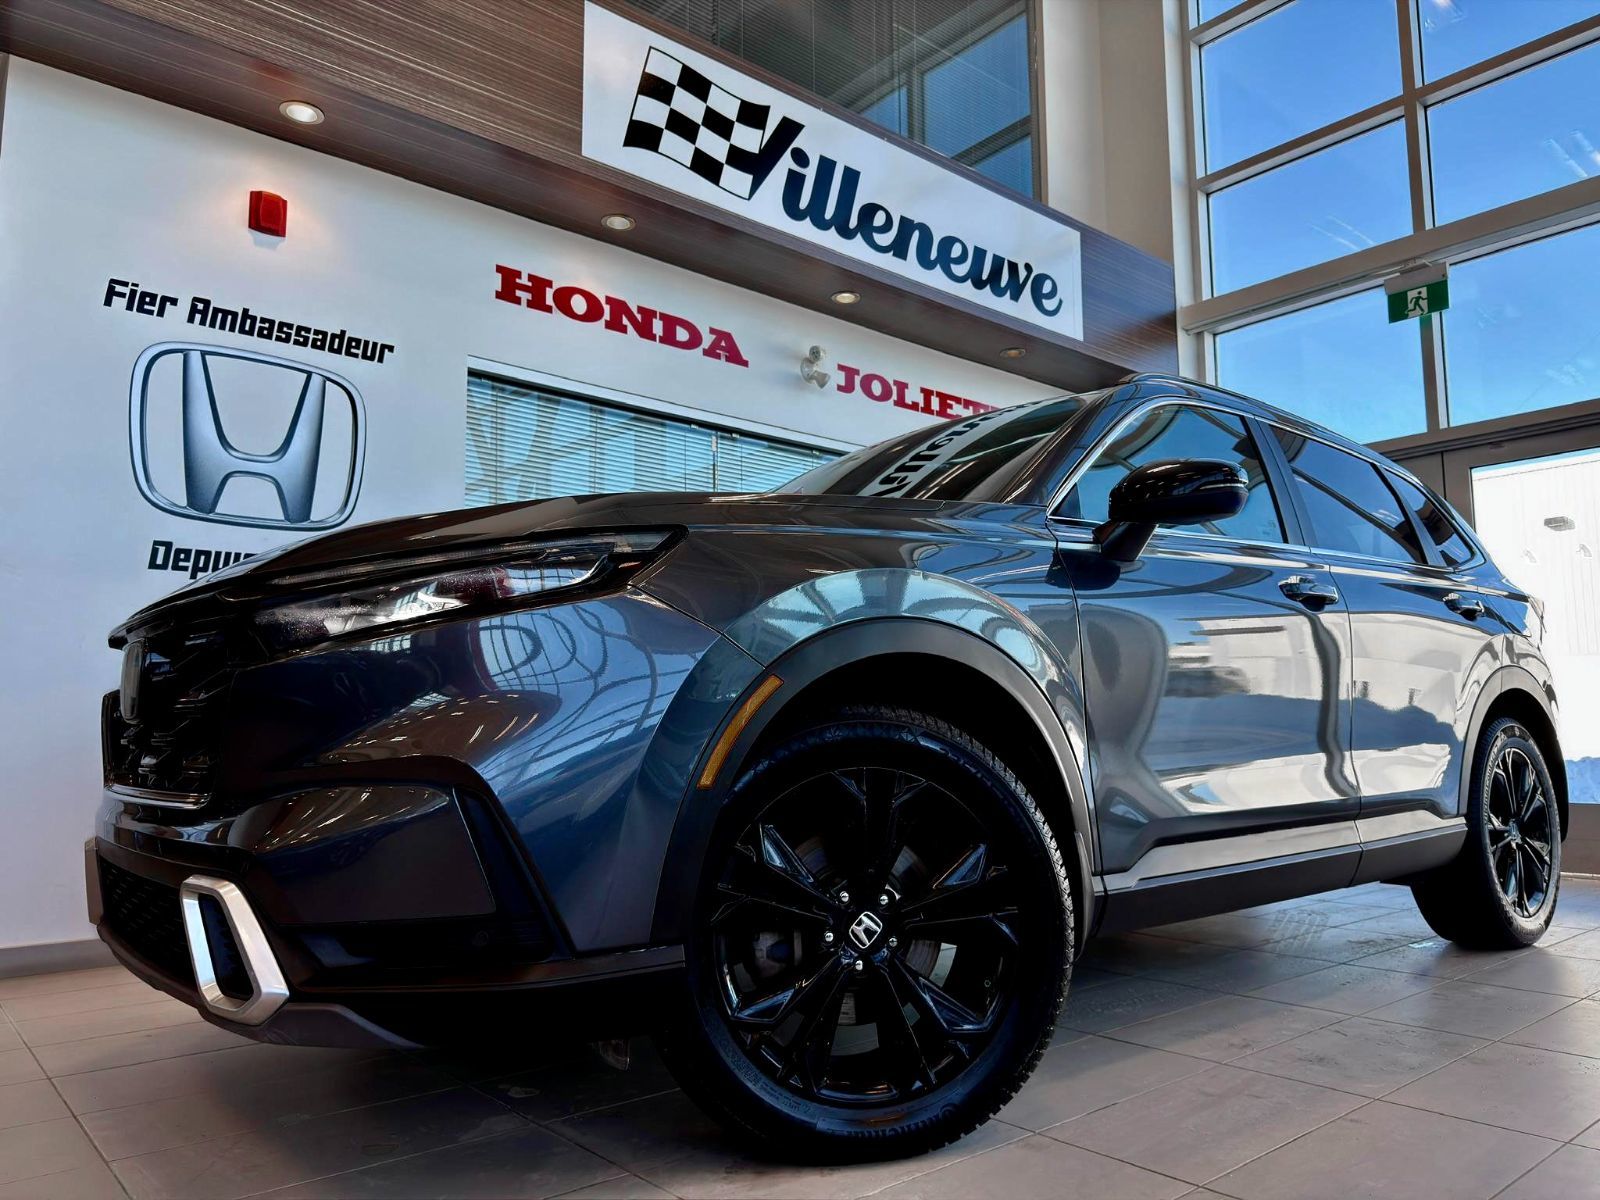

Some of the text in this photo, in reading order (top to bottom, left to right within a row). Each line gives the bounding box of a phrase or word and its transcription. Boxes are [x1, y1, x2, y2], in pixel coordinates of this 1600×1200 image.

[728, 105, 1063, 317] Villeneuve
[104, 278, 395, 364] Fier Ambassadeur
[496, 265, 1002, 420] HONDA JOLIET
